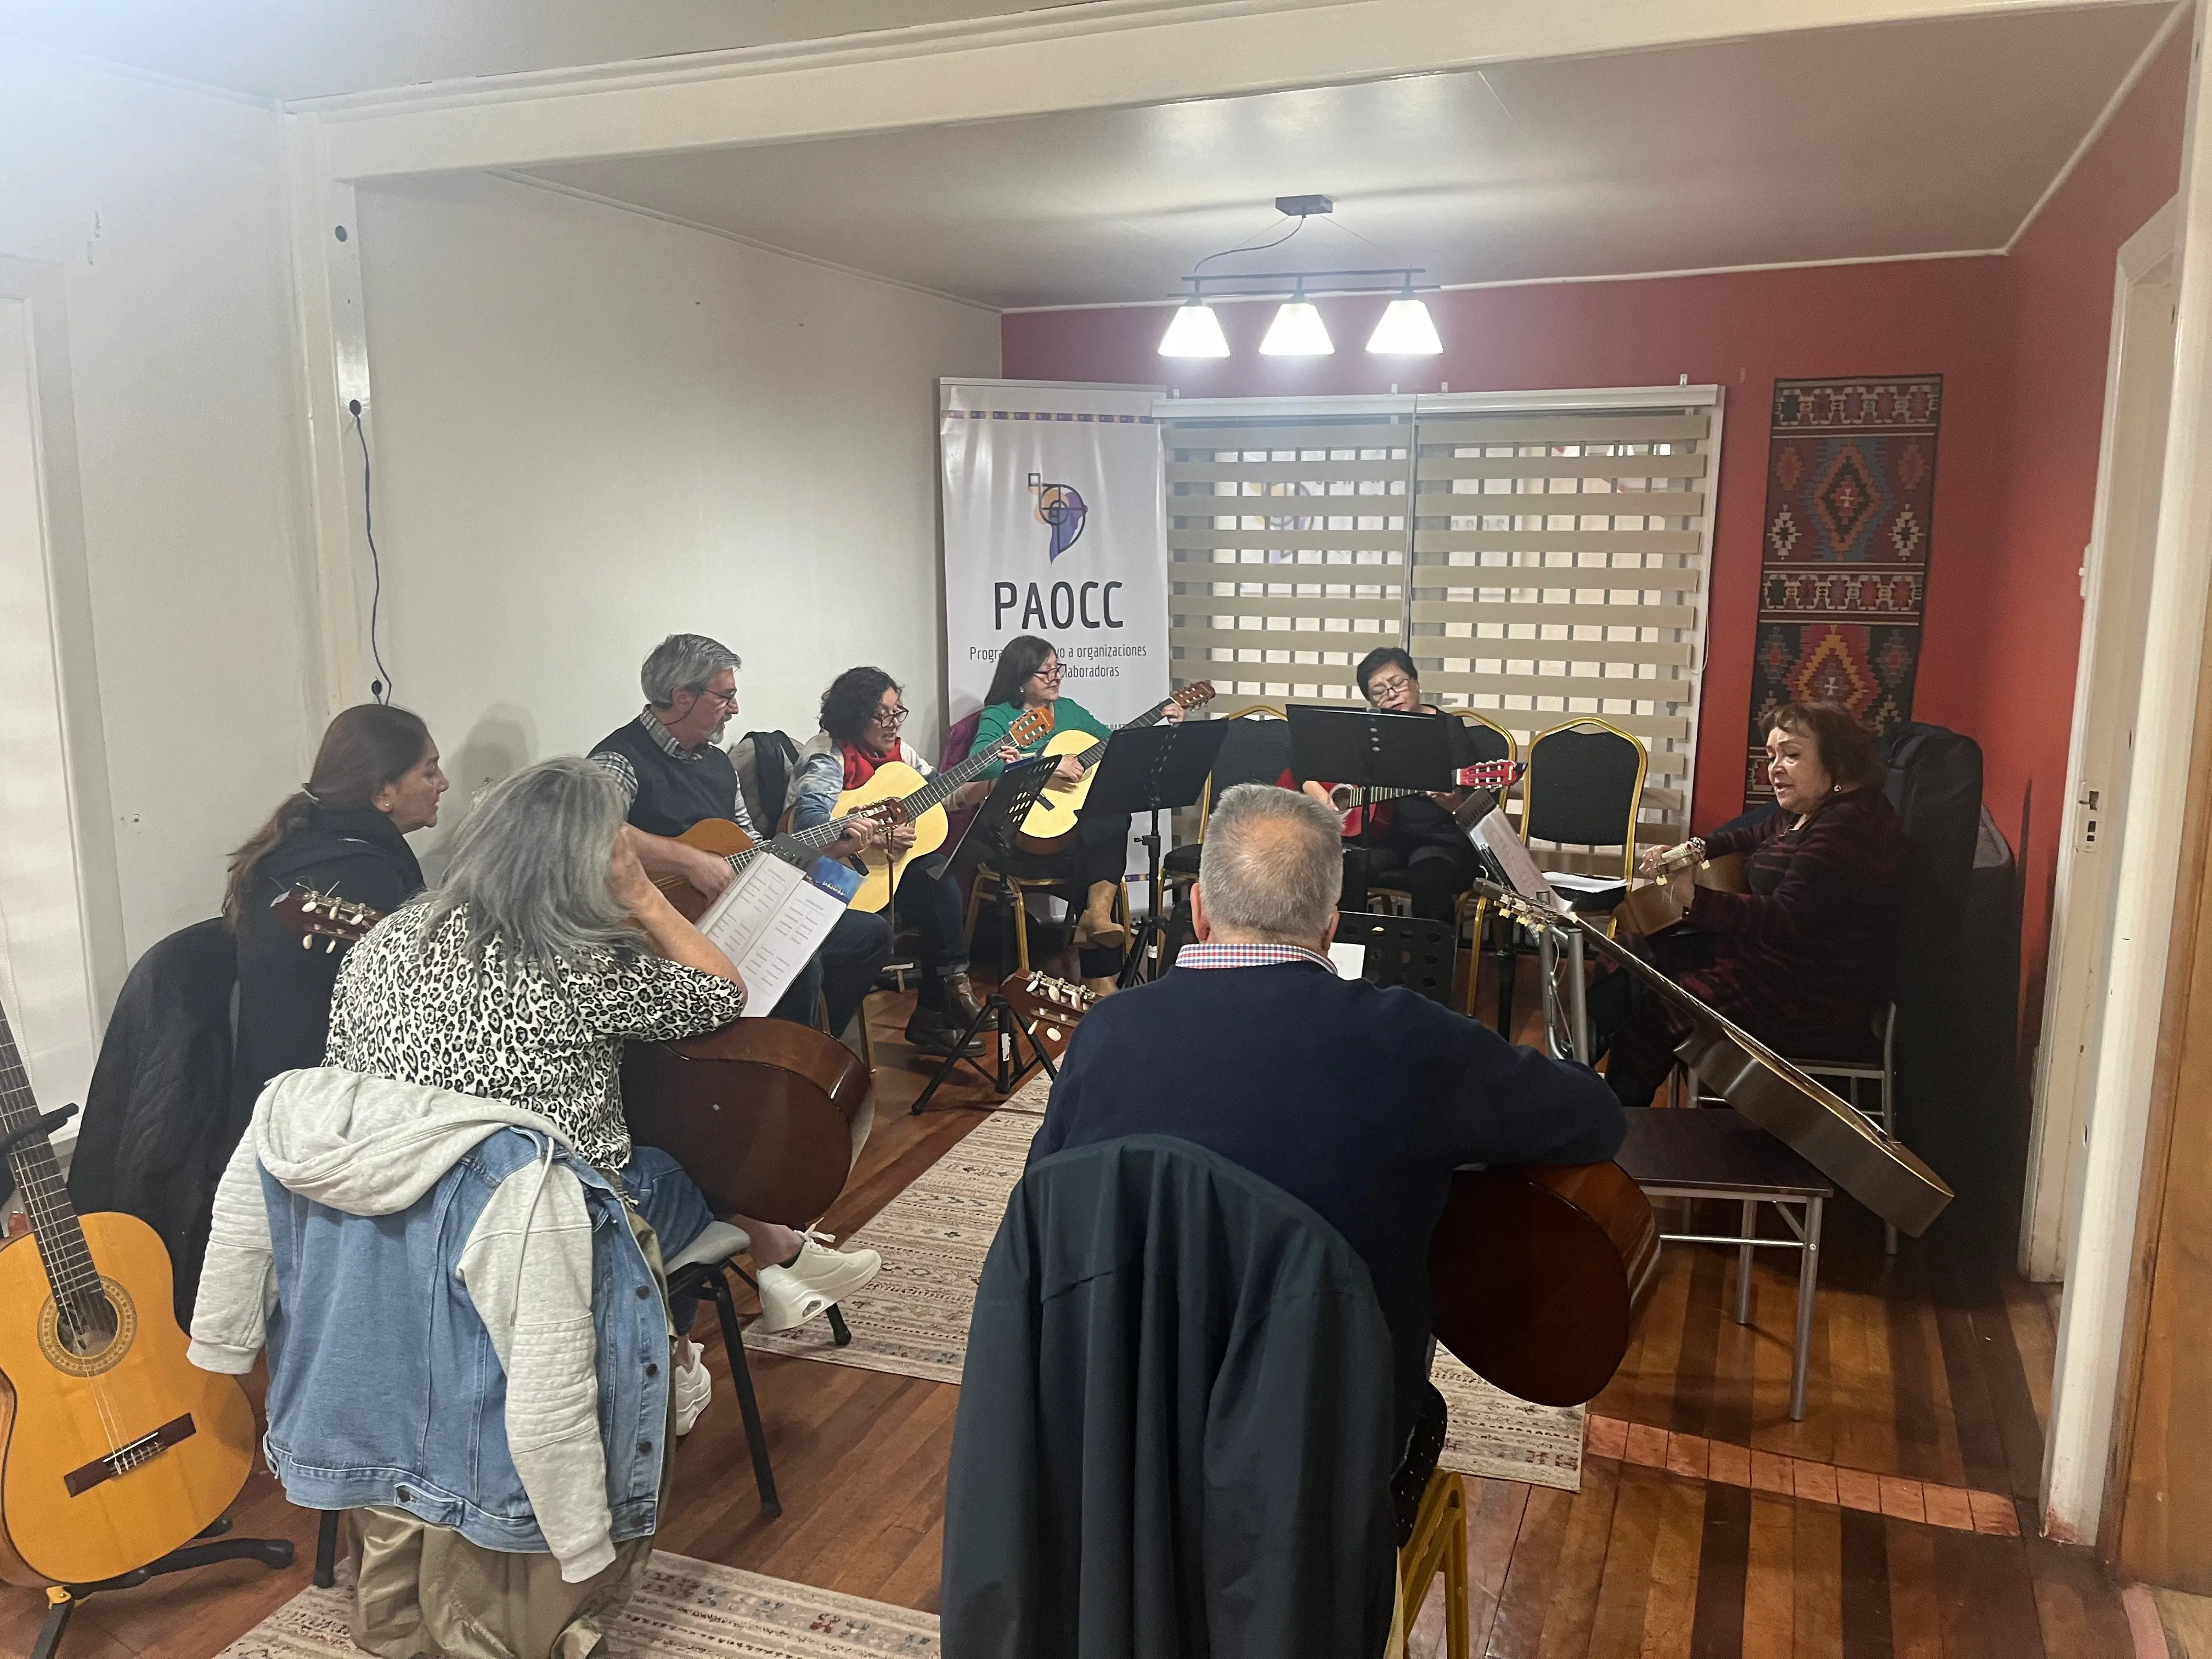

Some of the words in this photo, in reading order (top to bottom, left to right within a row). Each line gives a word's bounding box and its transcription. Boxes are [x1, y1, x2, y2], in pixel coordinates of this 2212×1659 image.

[994, 581, 1124, 630] PAOCC
[970, 647, 1003, 663] Progra
[1069, 647, 1074, 658] a
[1077, 644, 1147, 661] organizaciones
